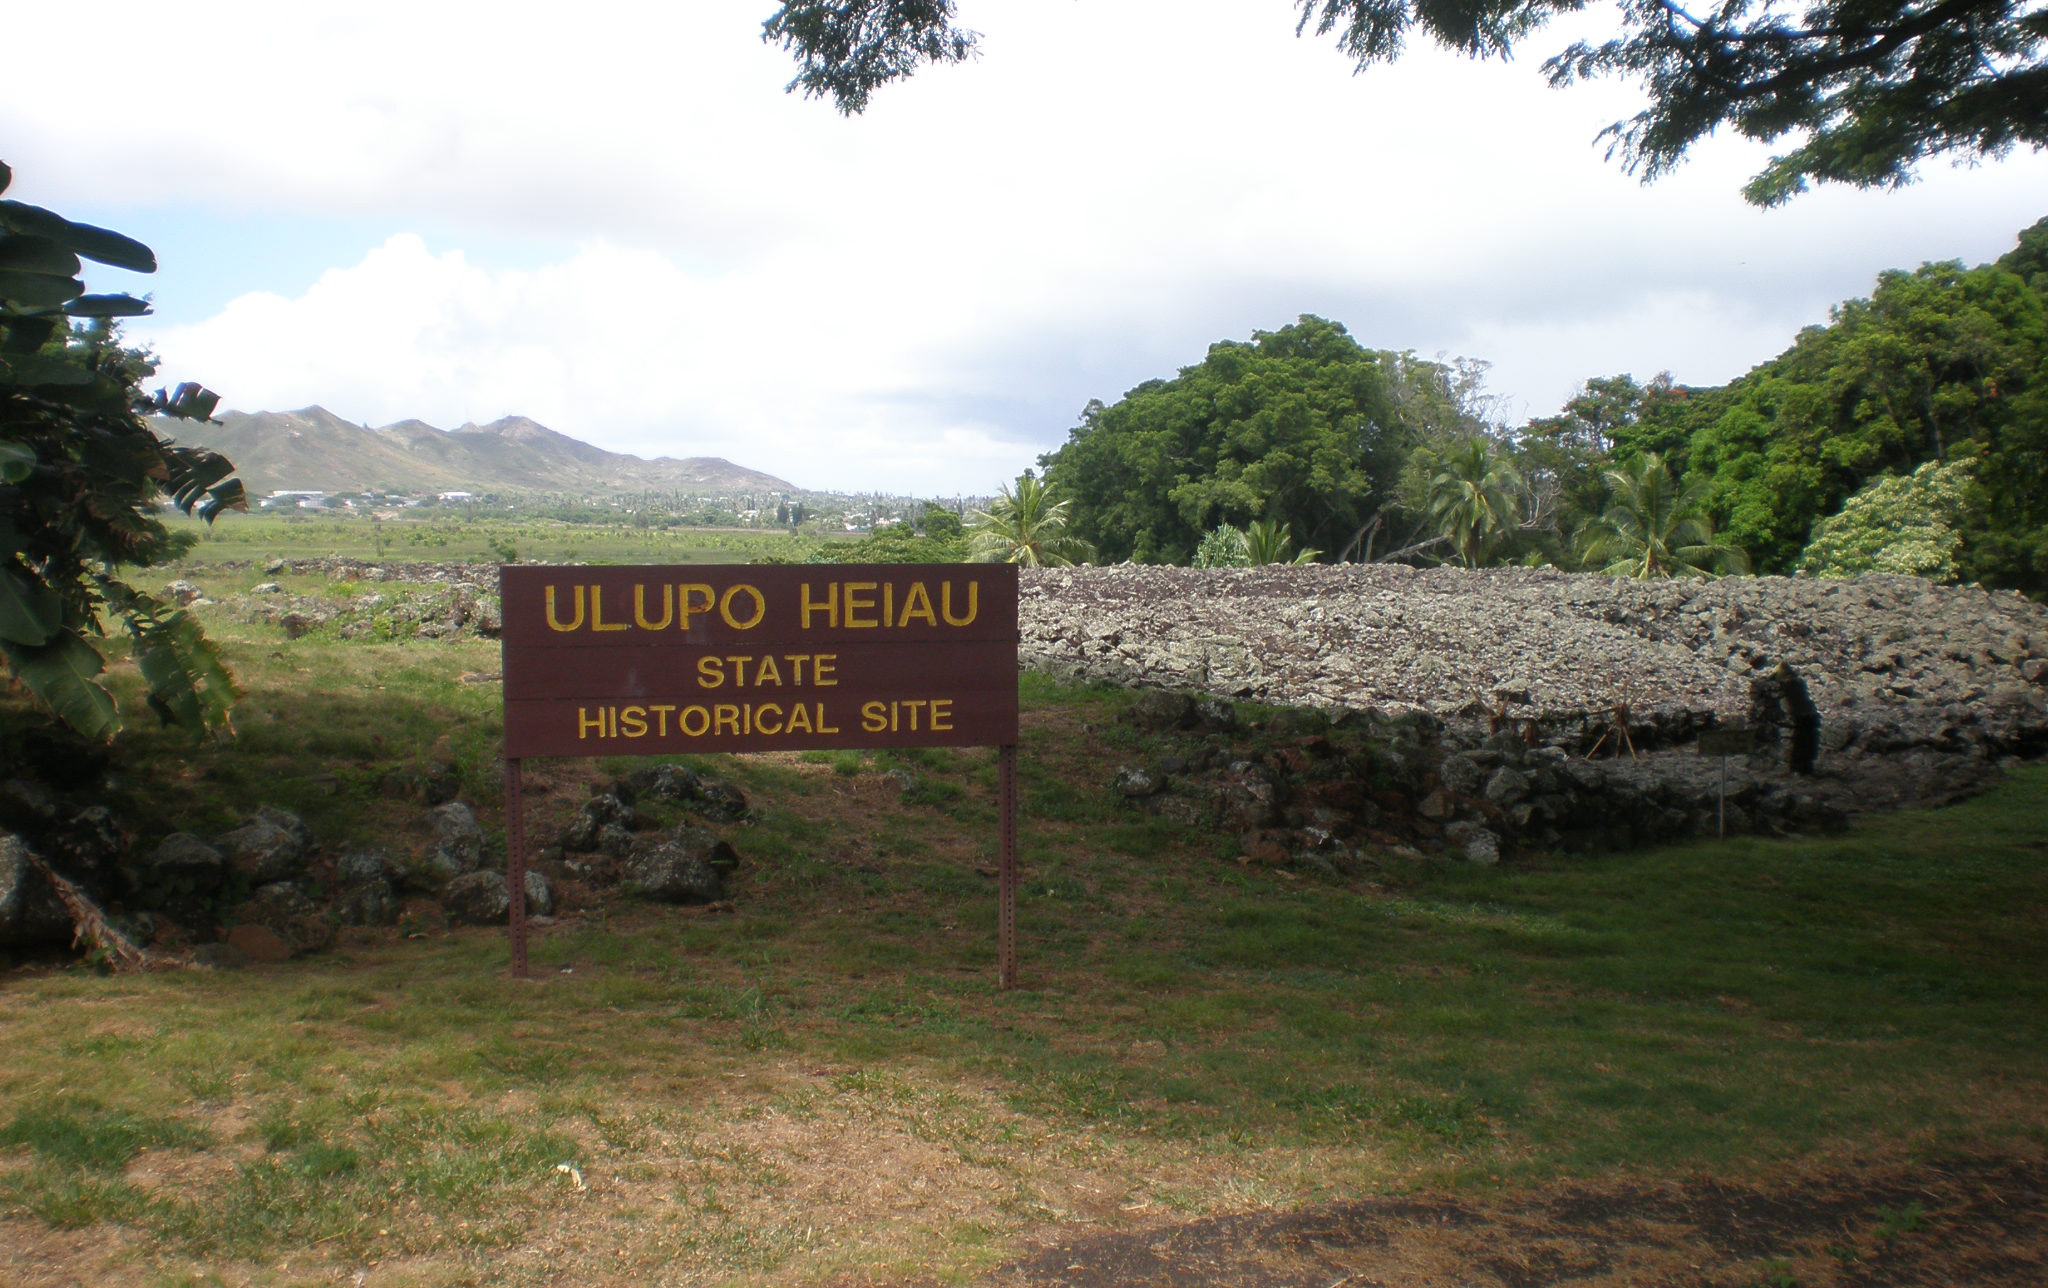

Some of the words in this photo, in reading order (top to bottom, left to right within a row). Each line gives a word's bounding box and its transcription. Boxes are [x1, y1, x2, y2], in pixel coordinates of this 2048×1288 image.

[545, 582, 767, 632] ULUPO
[800, 580, 979, 630] HEIAU
[696, 653, 839, 689] STATE
[577, 701, 840, 740] HISTORICAL
[861, 699, 954, 733] SITE
